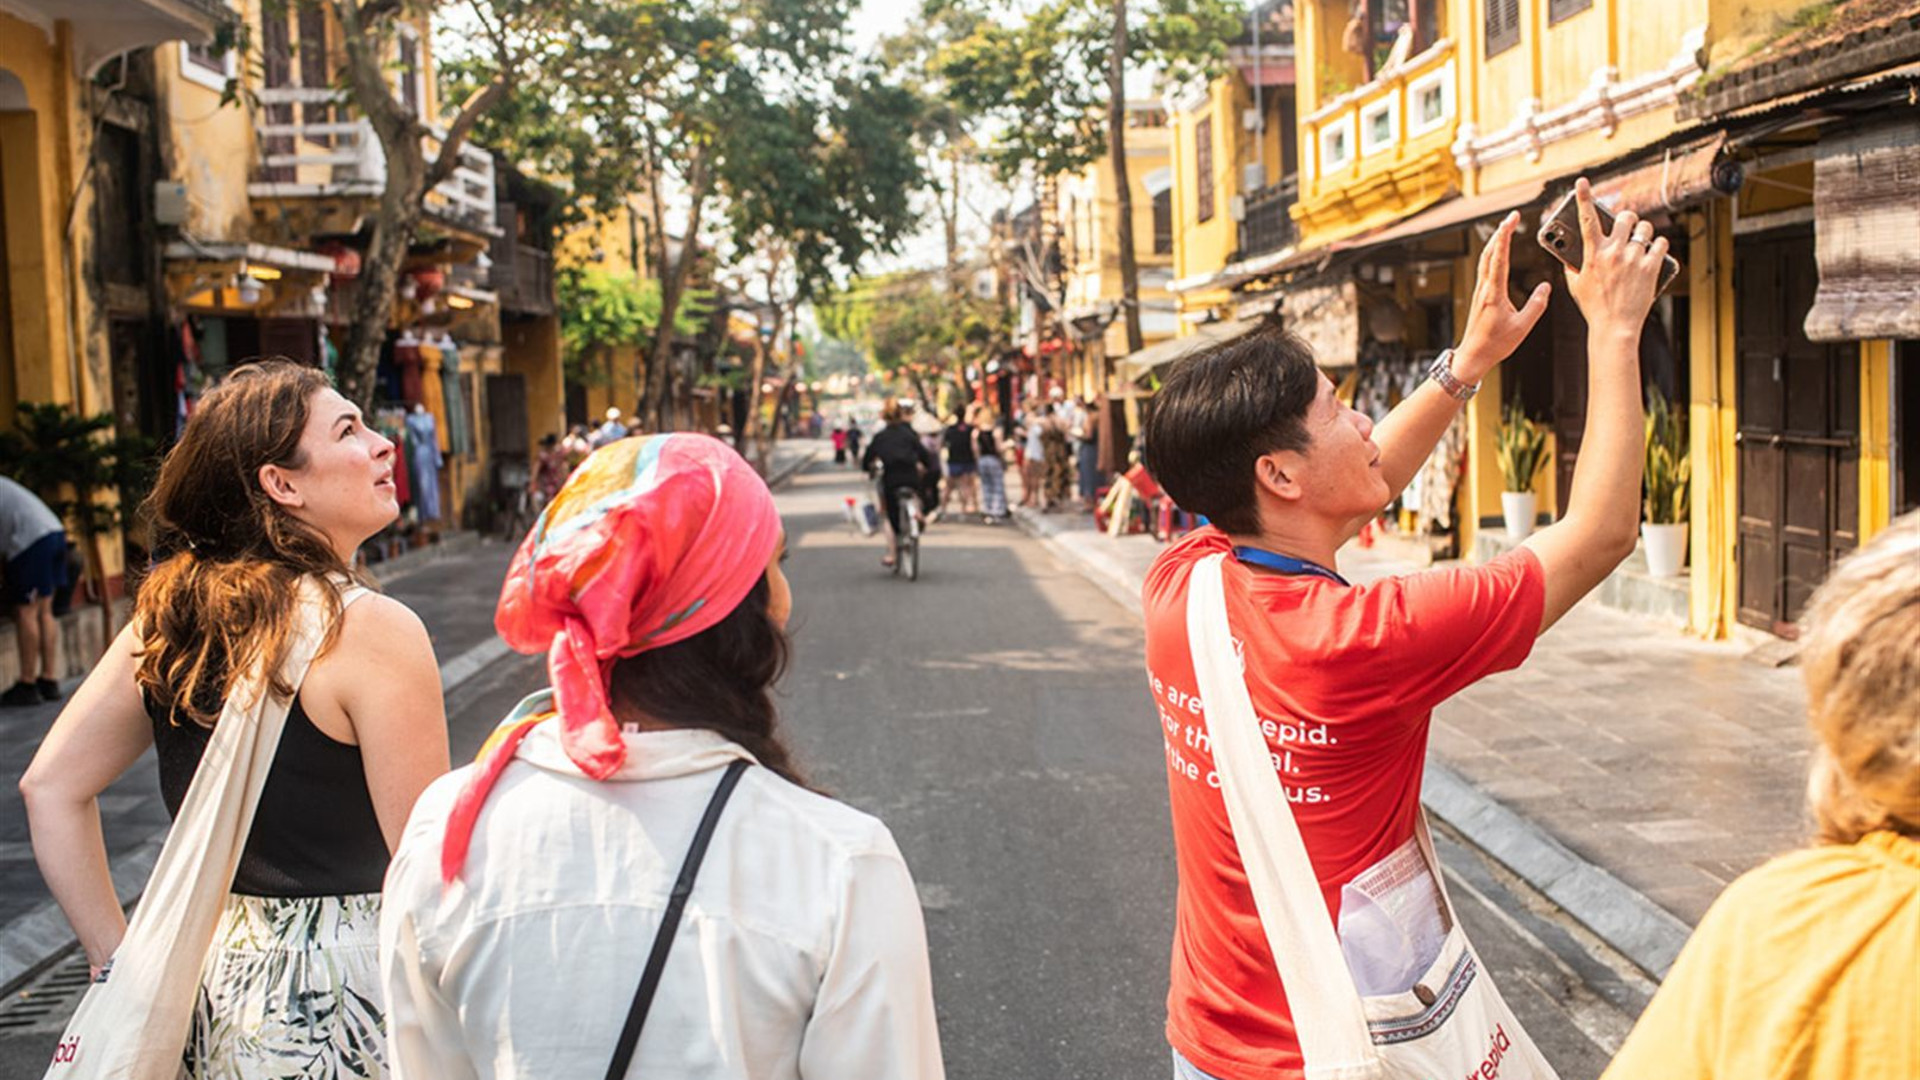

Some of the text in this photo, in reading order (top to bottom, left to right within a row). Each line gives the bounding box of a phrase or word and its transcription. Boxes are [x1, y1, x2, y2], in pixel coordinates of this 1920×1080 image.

[1167, 685, 1203, 715] are
[1261, 719, 1338, 745] epid.
[1171, 747, 1199, 780] the
[1285, 786, 1331, 803] us.
[1185, 725, 1211, 753] th
[1271, 751, 1300, 774] al.
[53, 1035, 81, 1068] pid
[1466, 1022, 1511, 1080] repid
